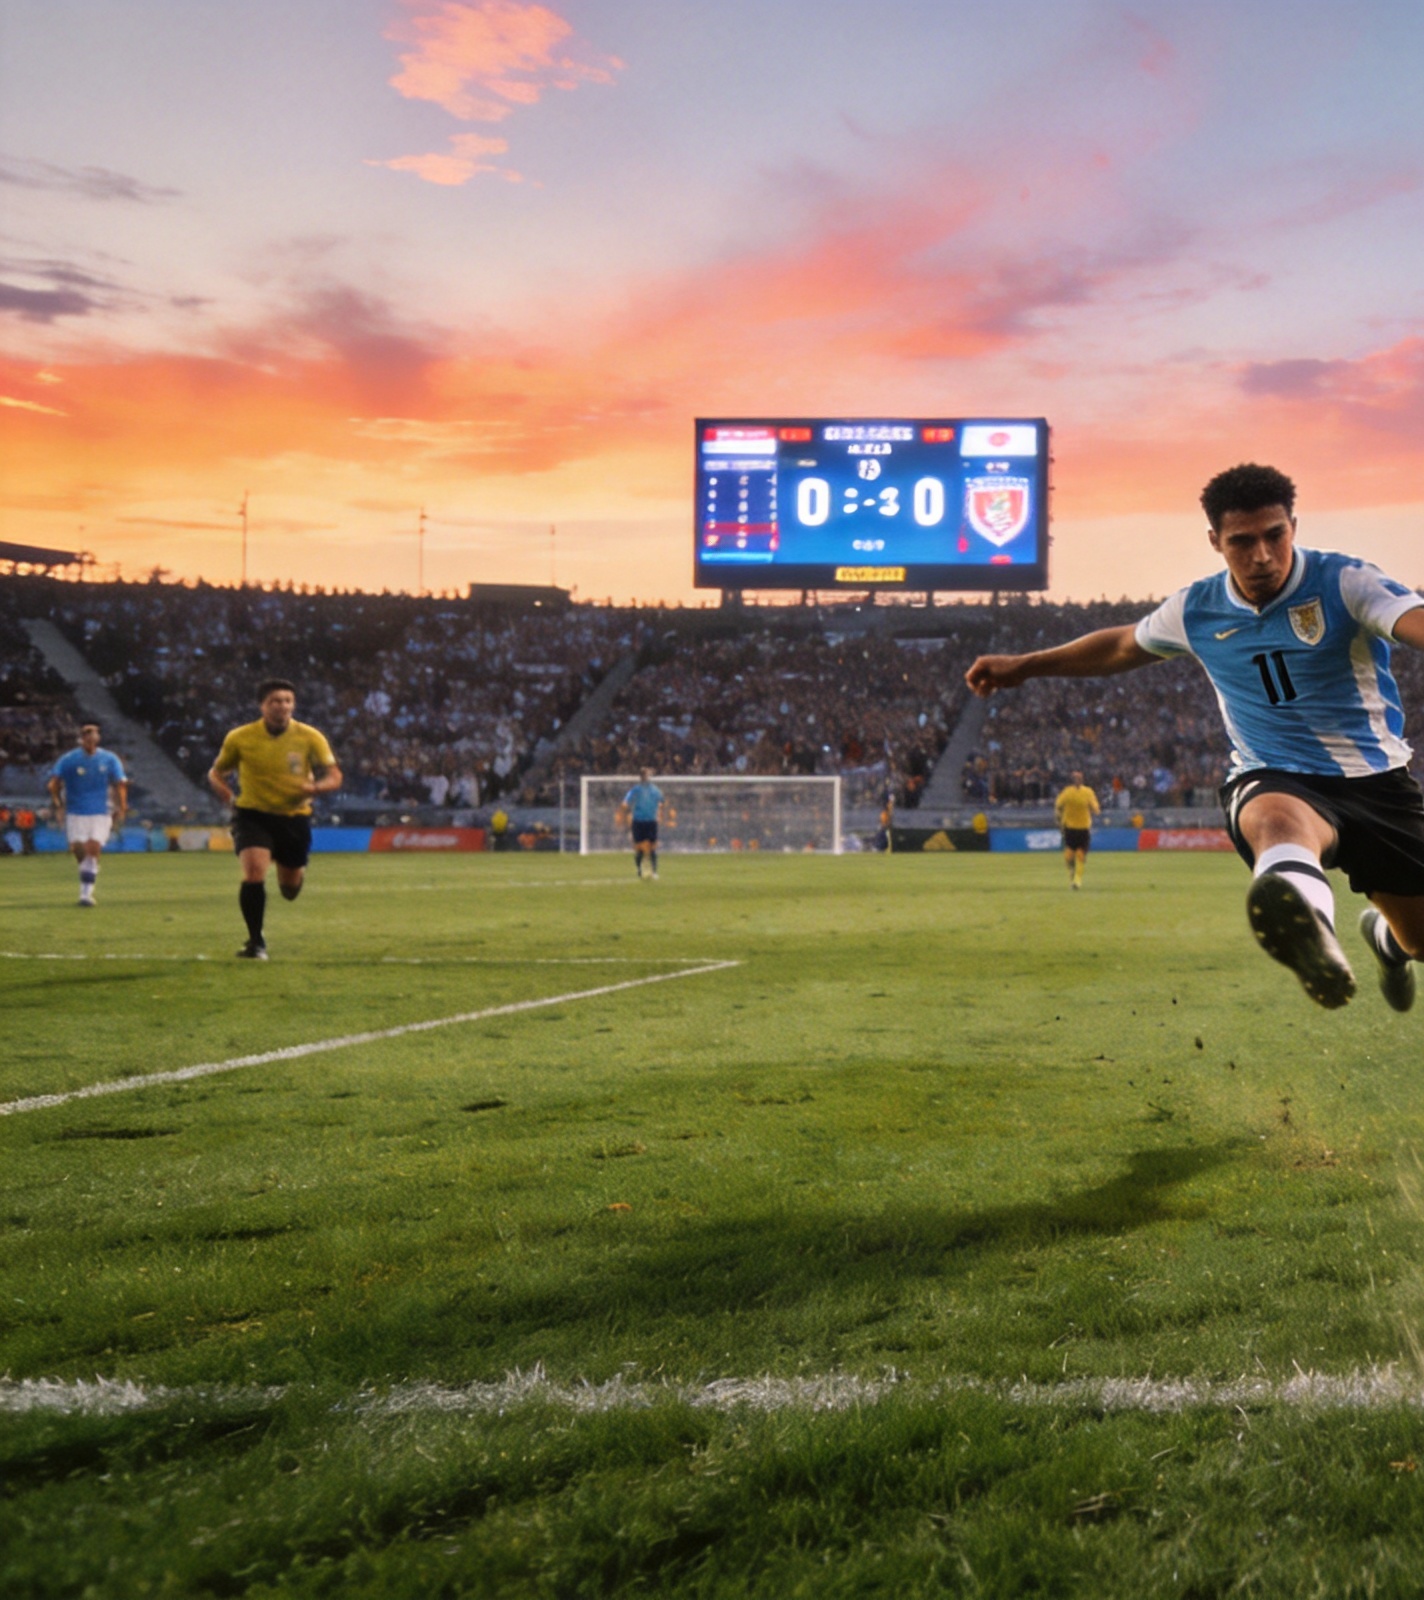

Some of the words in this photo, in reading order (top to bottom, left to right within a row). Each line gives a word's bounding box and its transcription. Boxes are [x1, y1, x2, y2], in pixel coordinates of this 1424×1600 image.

[798, 478, 829, 526] 0
[914, 477, 944, 526] 0
[1252, 650, 1297, 705] 11
